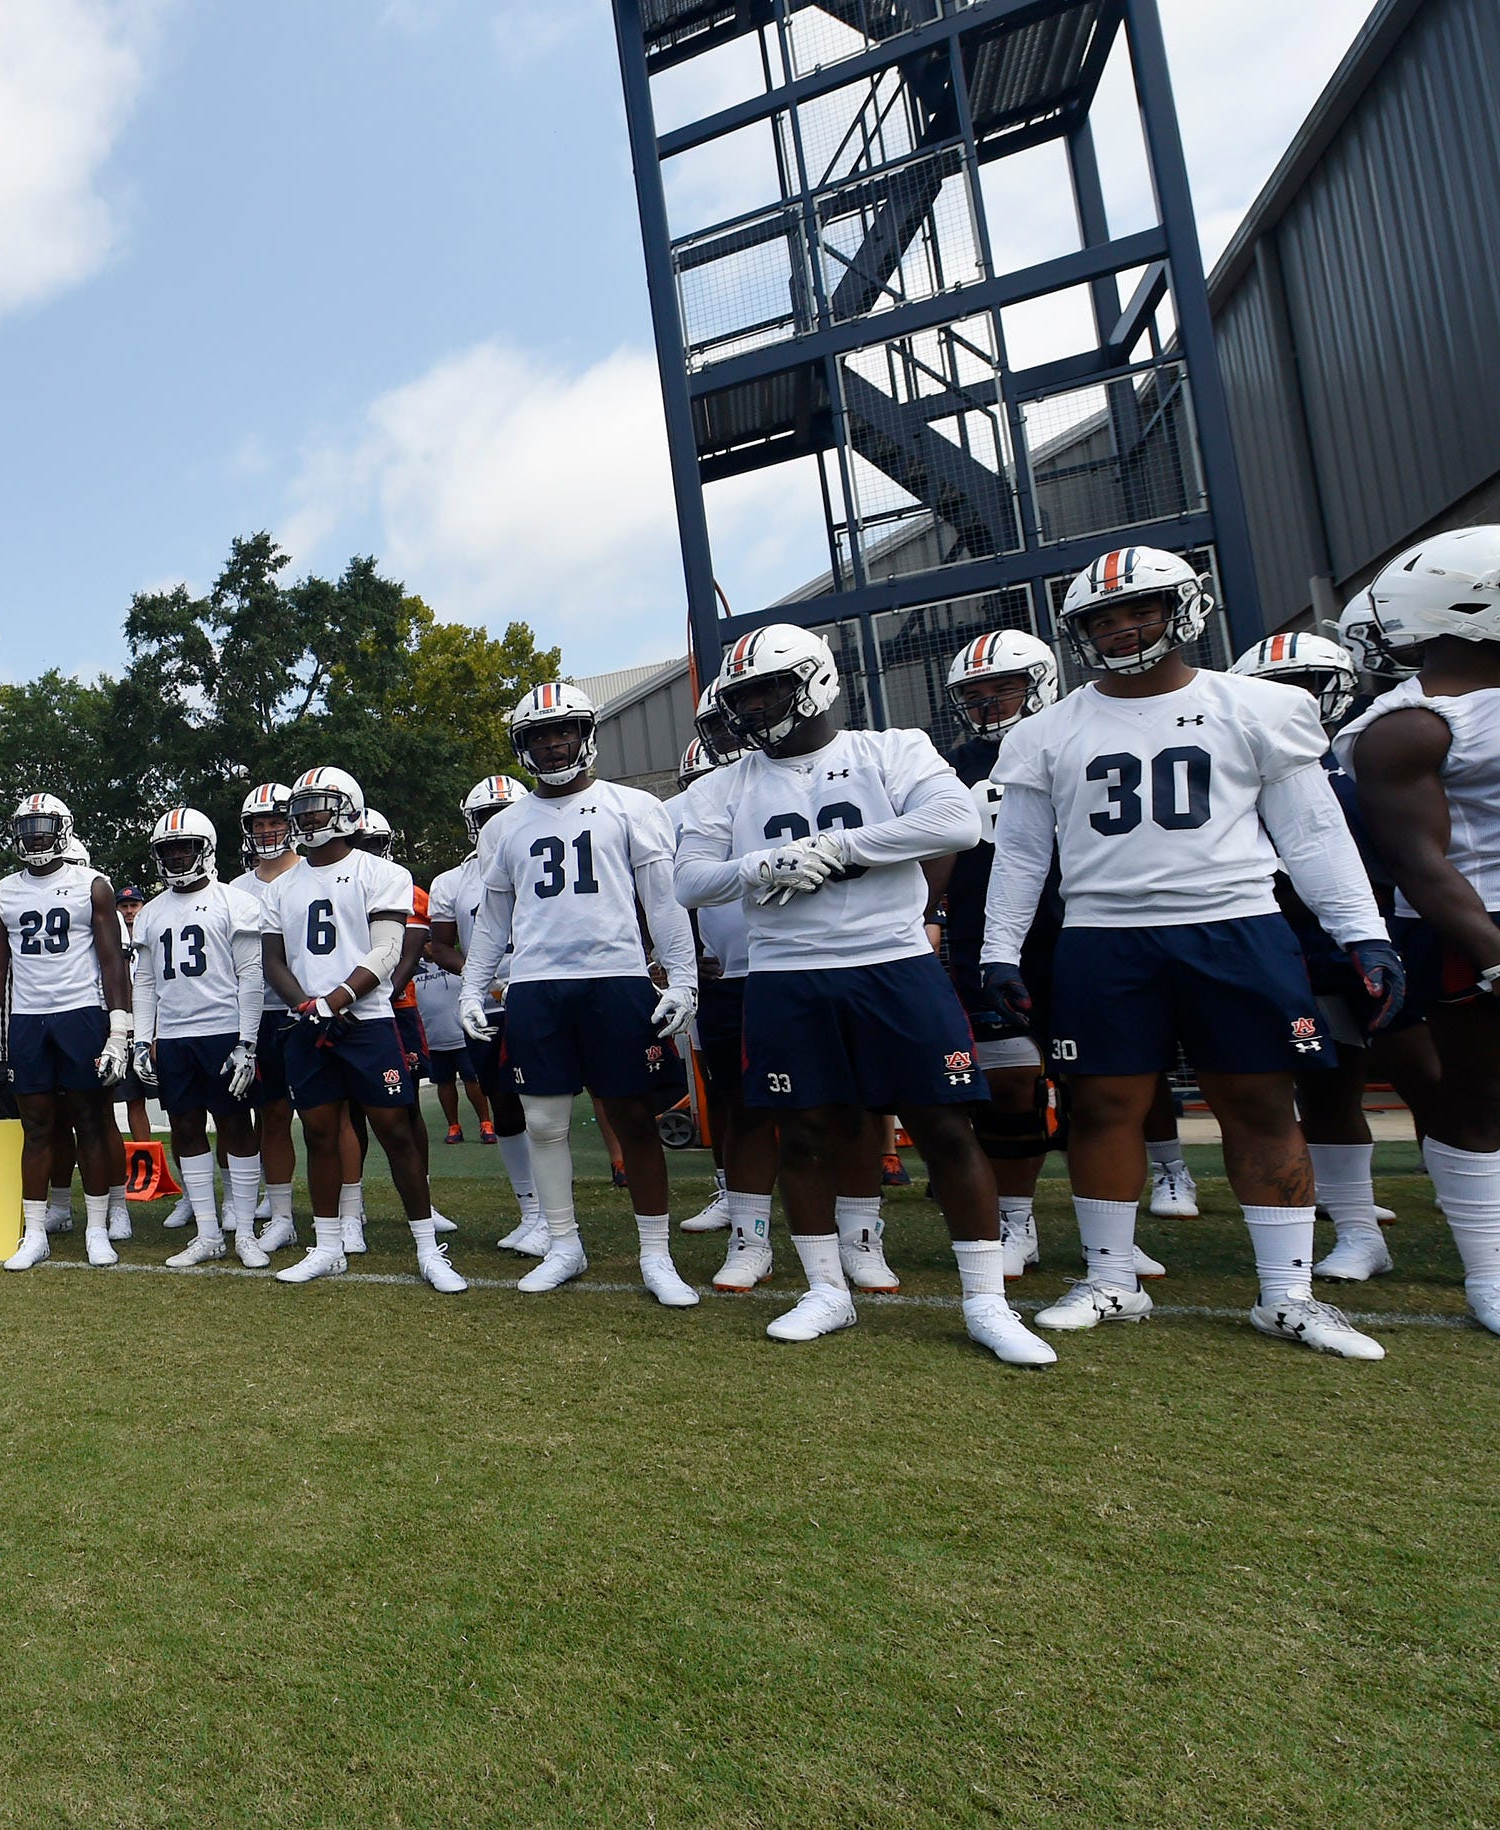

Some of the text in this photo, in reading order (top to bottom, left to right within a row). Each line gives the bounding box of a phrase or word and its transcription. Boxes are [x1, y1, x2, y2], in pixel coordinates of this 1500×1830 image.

[1086, 745, 1211, 837] 30
[530, 830, 599, 899] 31
[19, 907, 71, 955] 29
[306, 899, 337, 956] 6
[159, 924, 208, 980] 13
[1051, 1039, 1077, 1060] 30
[513, 1067, 525, 1084] 31
[767, 1073, 792, 1093] 33
[126, 1149, 153, 1193] 0
